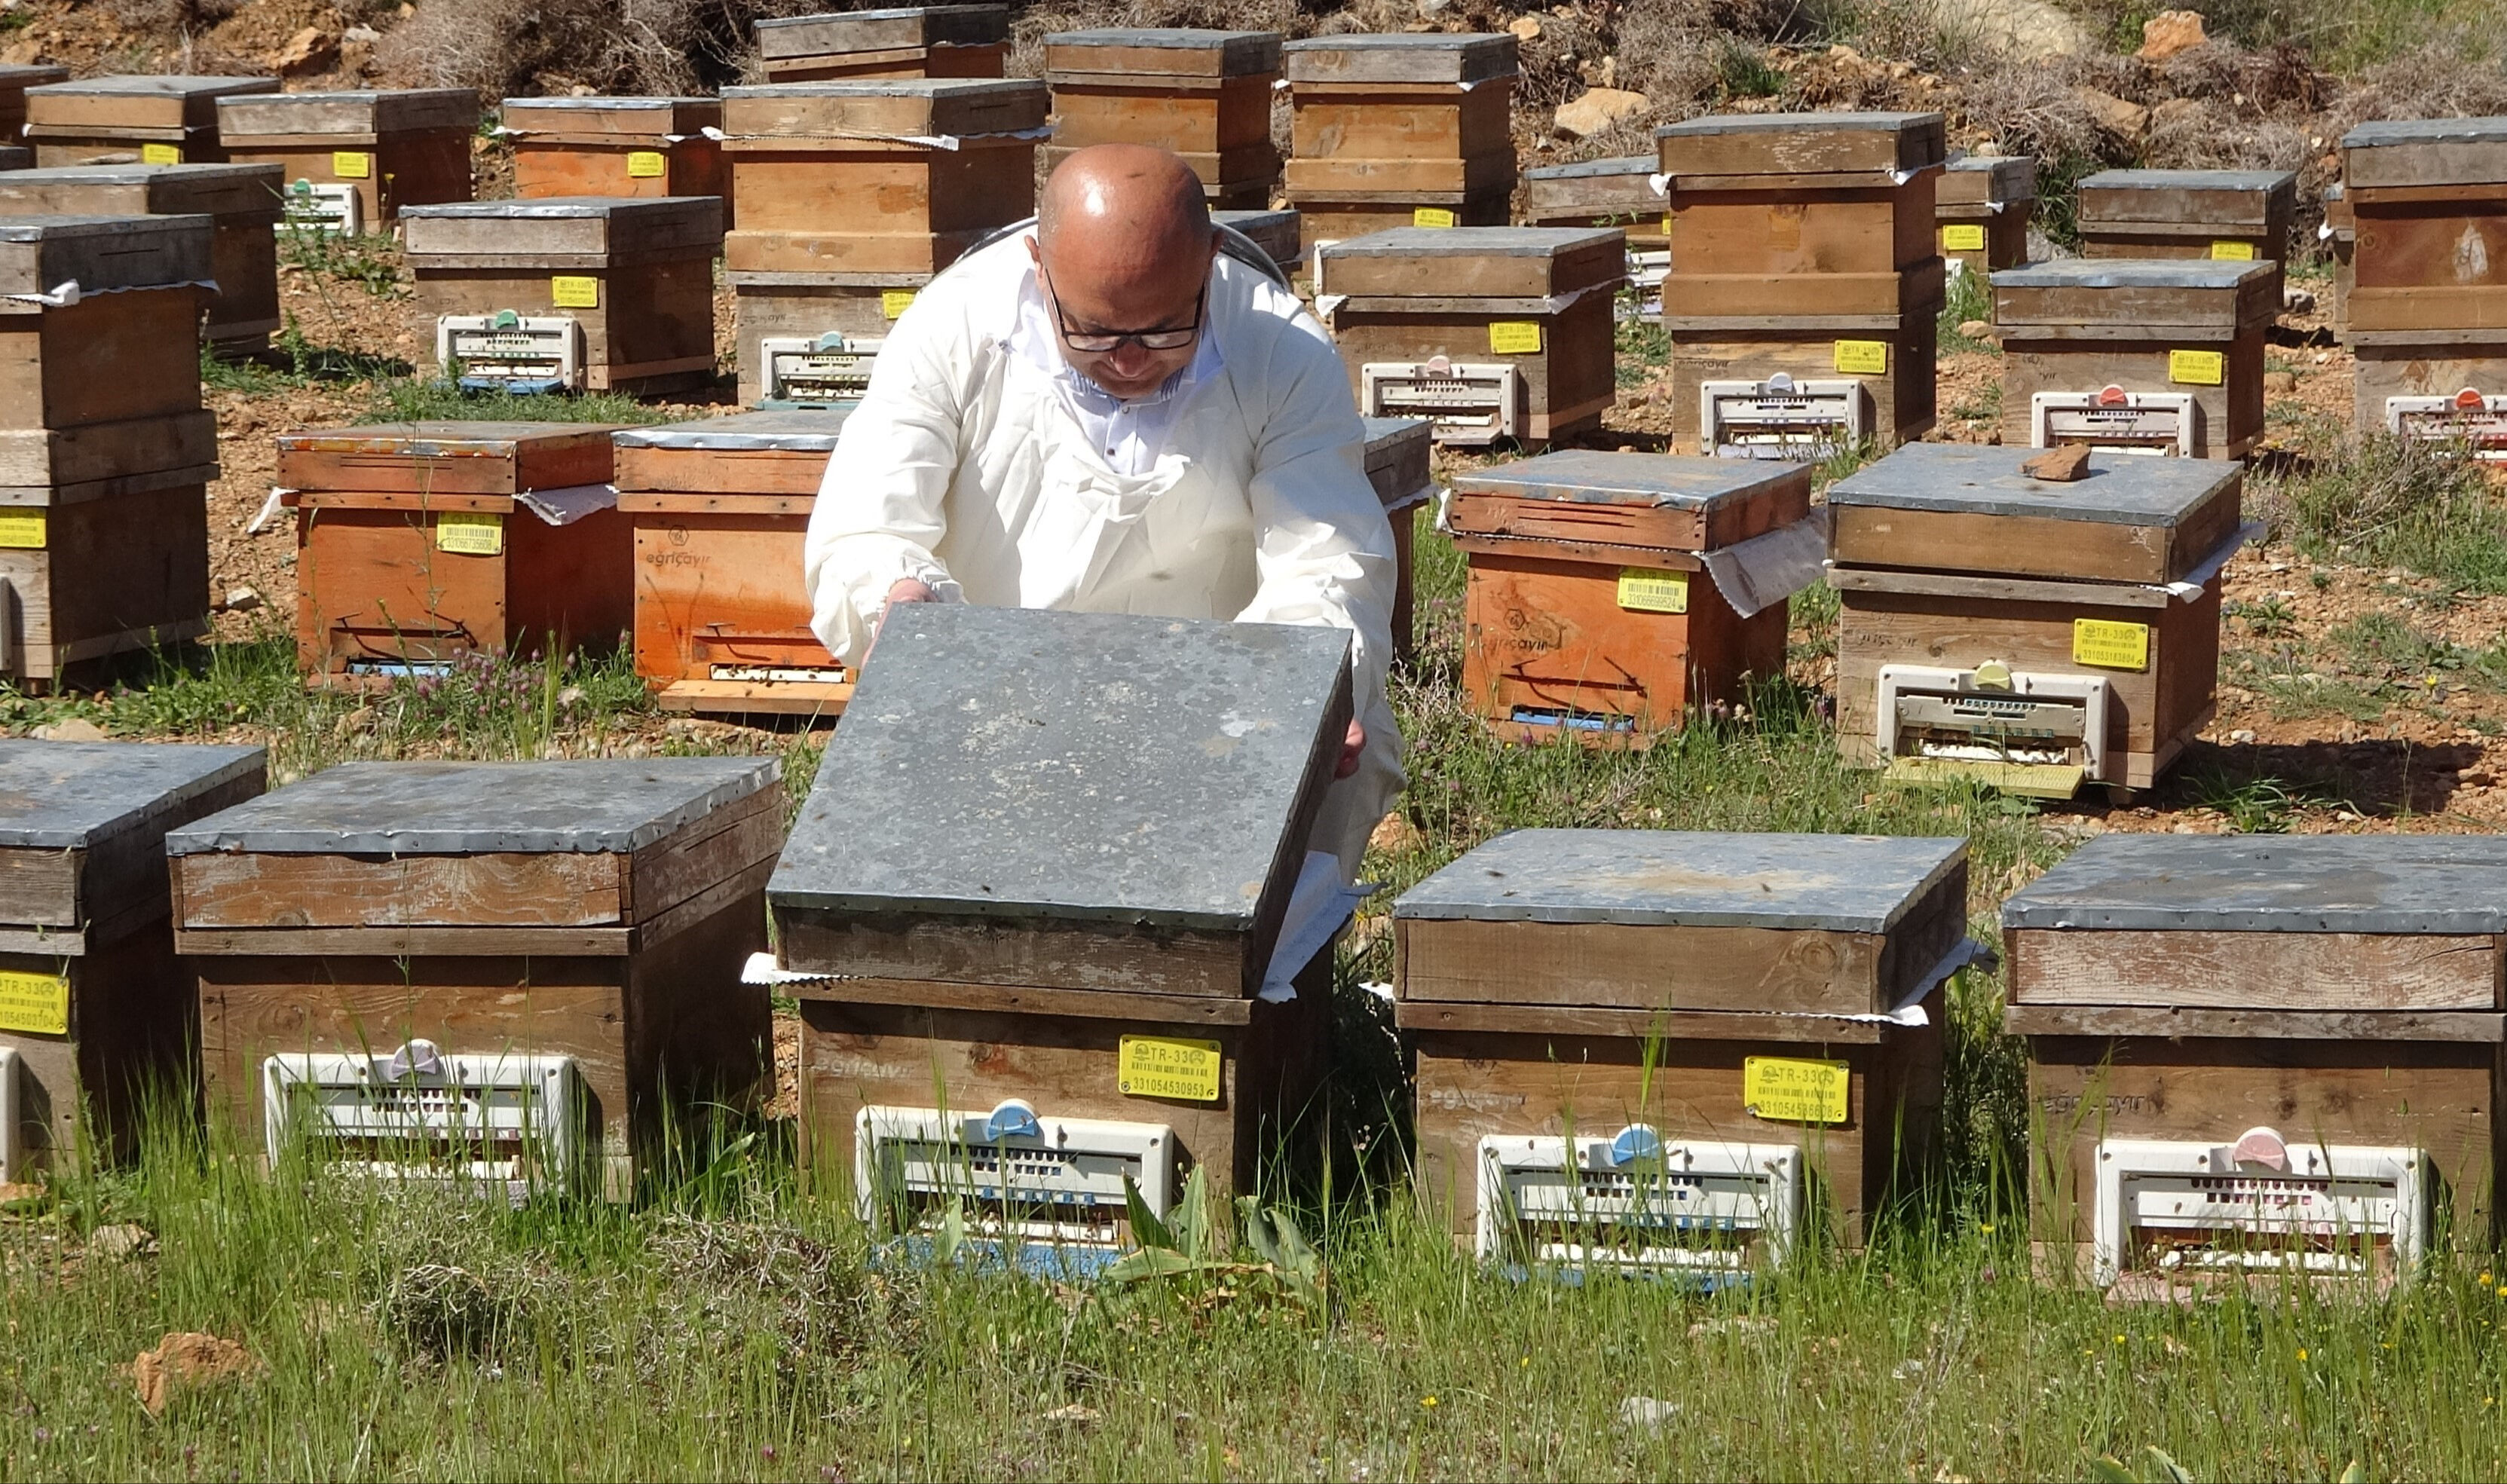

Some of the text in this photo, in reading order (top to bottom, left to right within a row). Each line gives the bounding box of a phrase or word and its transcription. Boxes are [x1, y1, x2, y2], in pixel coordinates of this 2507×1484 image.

[3, 980, 39, 996] TR-33
[1151, 1048, 1189, 1064] TR-33
[1779, 1067, 1817, 1084] TR-33
[1134, 1077, 1205, 1097] 331054530953
